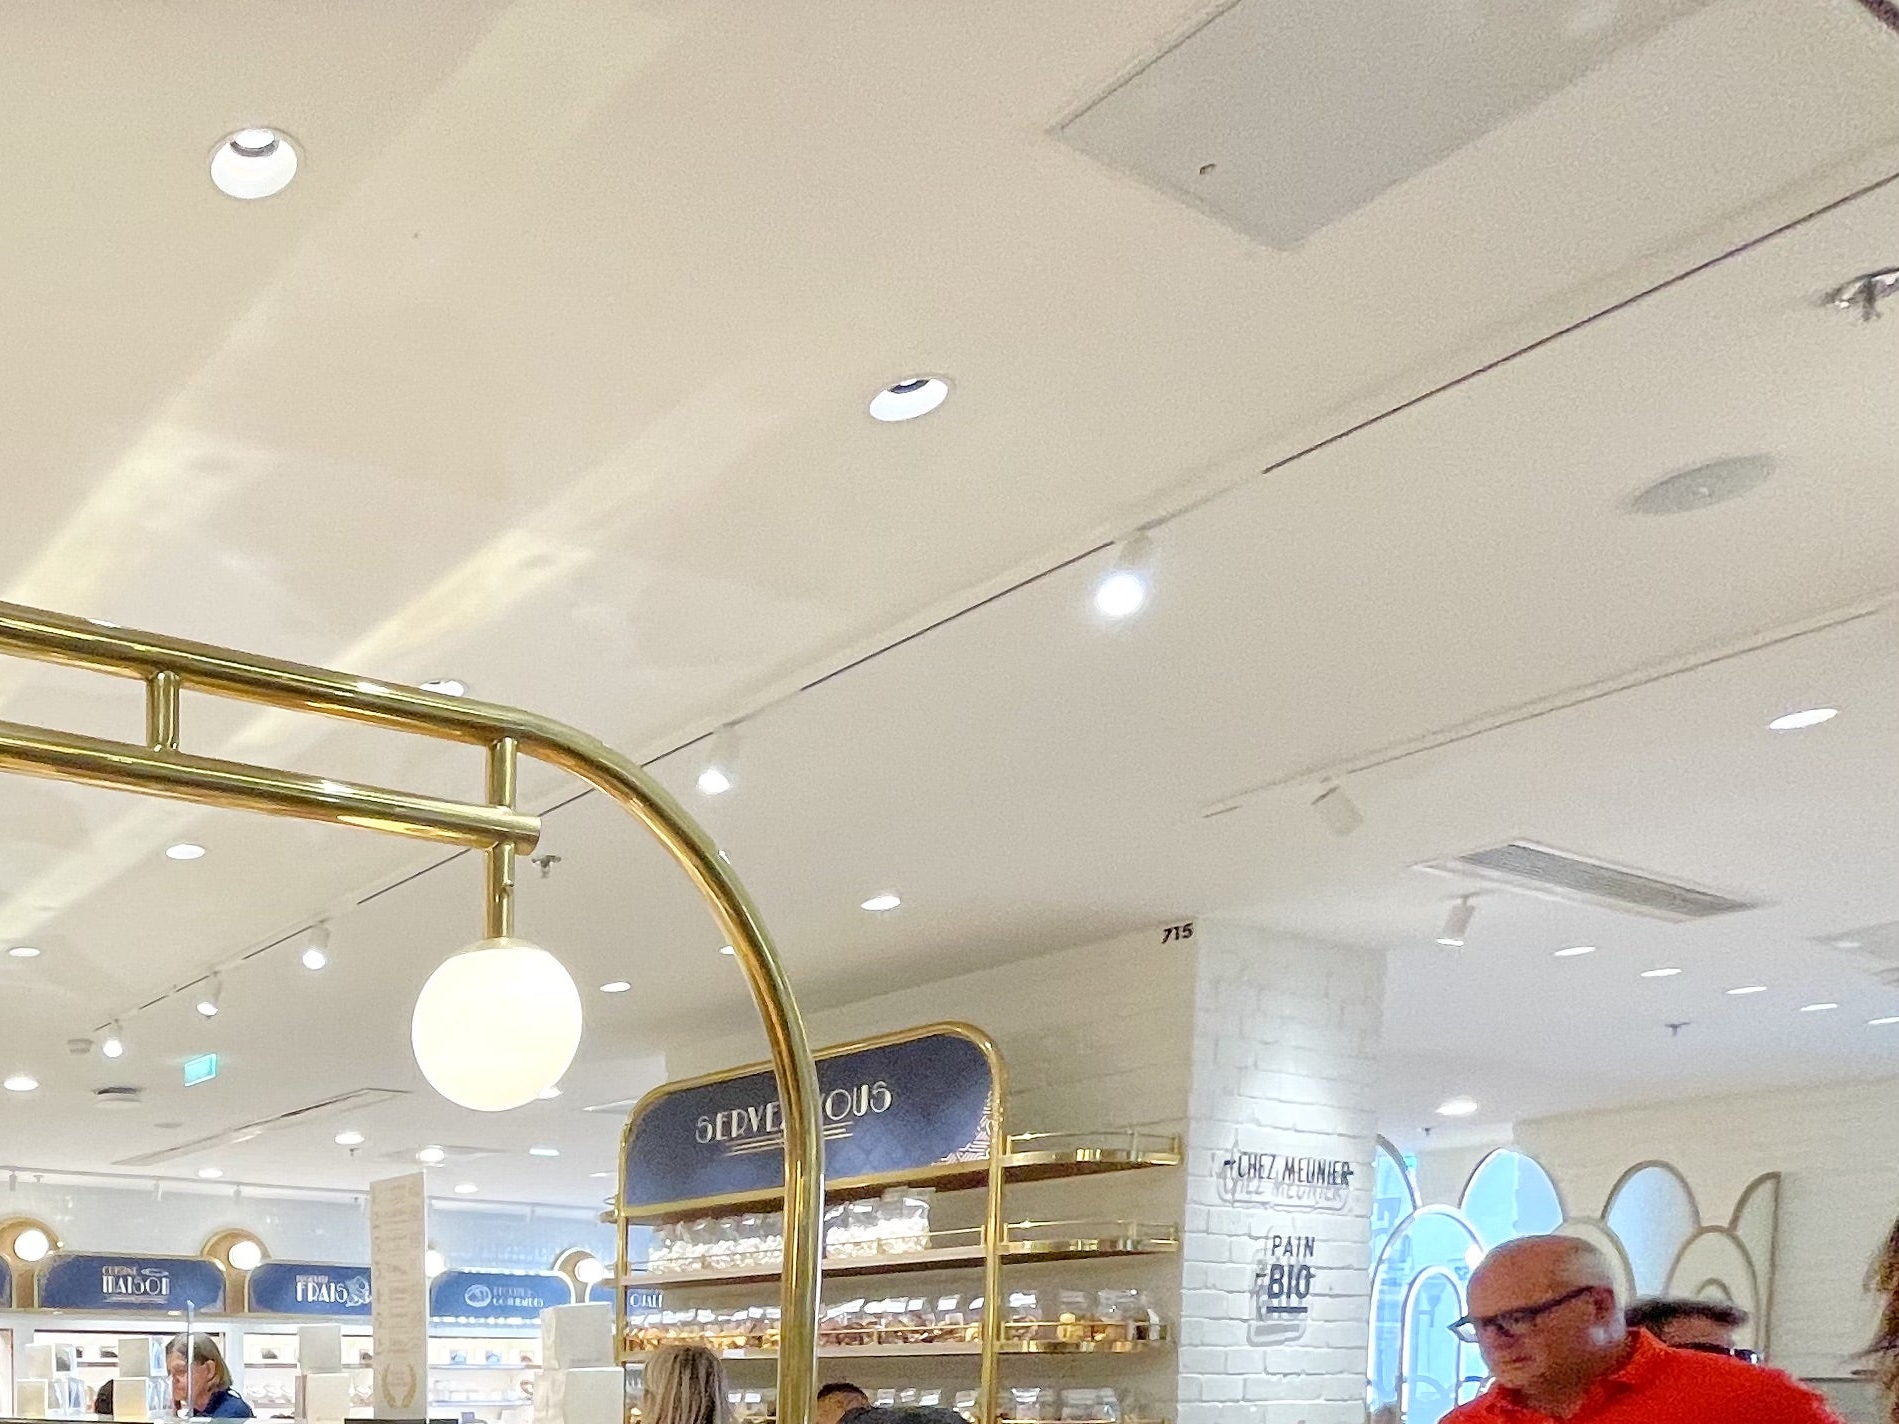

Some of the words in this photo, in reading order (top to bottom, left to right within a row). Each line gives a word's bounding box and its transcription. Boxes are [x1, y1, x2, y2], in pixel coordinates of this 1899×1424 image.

[1161, 922, 1194, 944] 715
[696, 1101, 786, 1143] SERVE
[821, 1081, 892, 1121] OUS
[1238, 1153, 1276, 1180] CHEZ
[1282, 1156, 1350, 1187] MEUNIER
[1271, 1235, 1315, 1257] PAIN
[102, 1276, 170, 1295] MAISON
[296, 1282, 349, 1303] FRAIS
[1267, 1264, 1312, 1299] BIO
